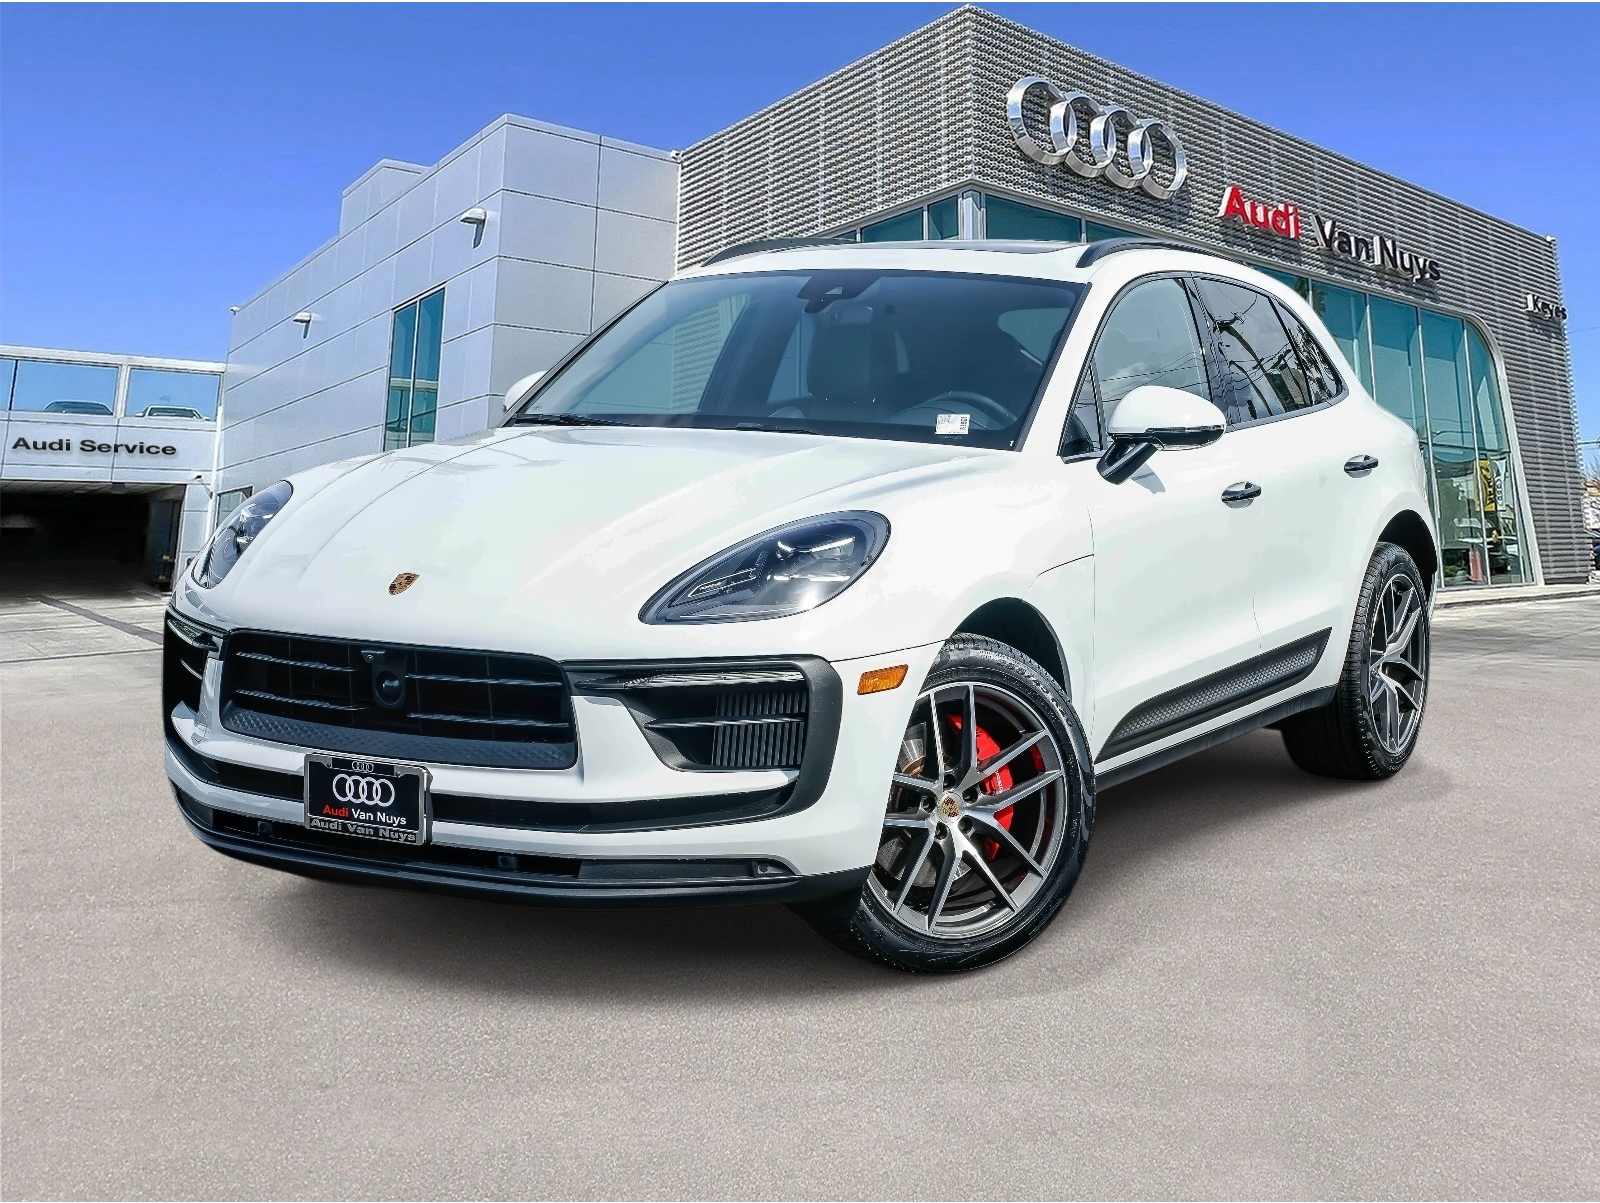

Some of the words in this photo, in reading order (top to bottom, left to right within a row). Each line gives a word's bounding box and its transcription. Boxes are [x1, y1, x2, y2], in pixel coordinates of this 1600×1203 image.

[1216, 184, 1300, 240] Audi
[1310, 214, 1371, 261] Van
[1374, 235, 1440, 283] Nuys
[1527, 294, 1567, 320] Keyes
[12, 437, 71, 451] Audi
[80, 440, 177, 455] Service
[322, 804, 349, 817] Audi
[352, 808, 374, 821] Van
[377, 812, 407, 827] Nuys
[310, 818, 342, 831] Audi
[347, 823, 374, 835] Van
[379, 829, 416, 841] Nuys
